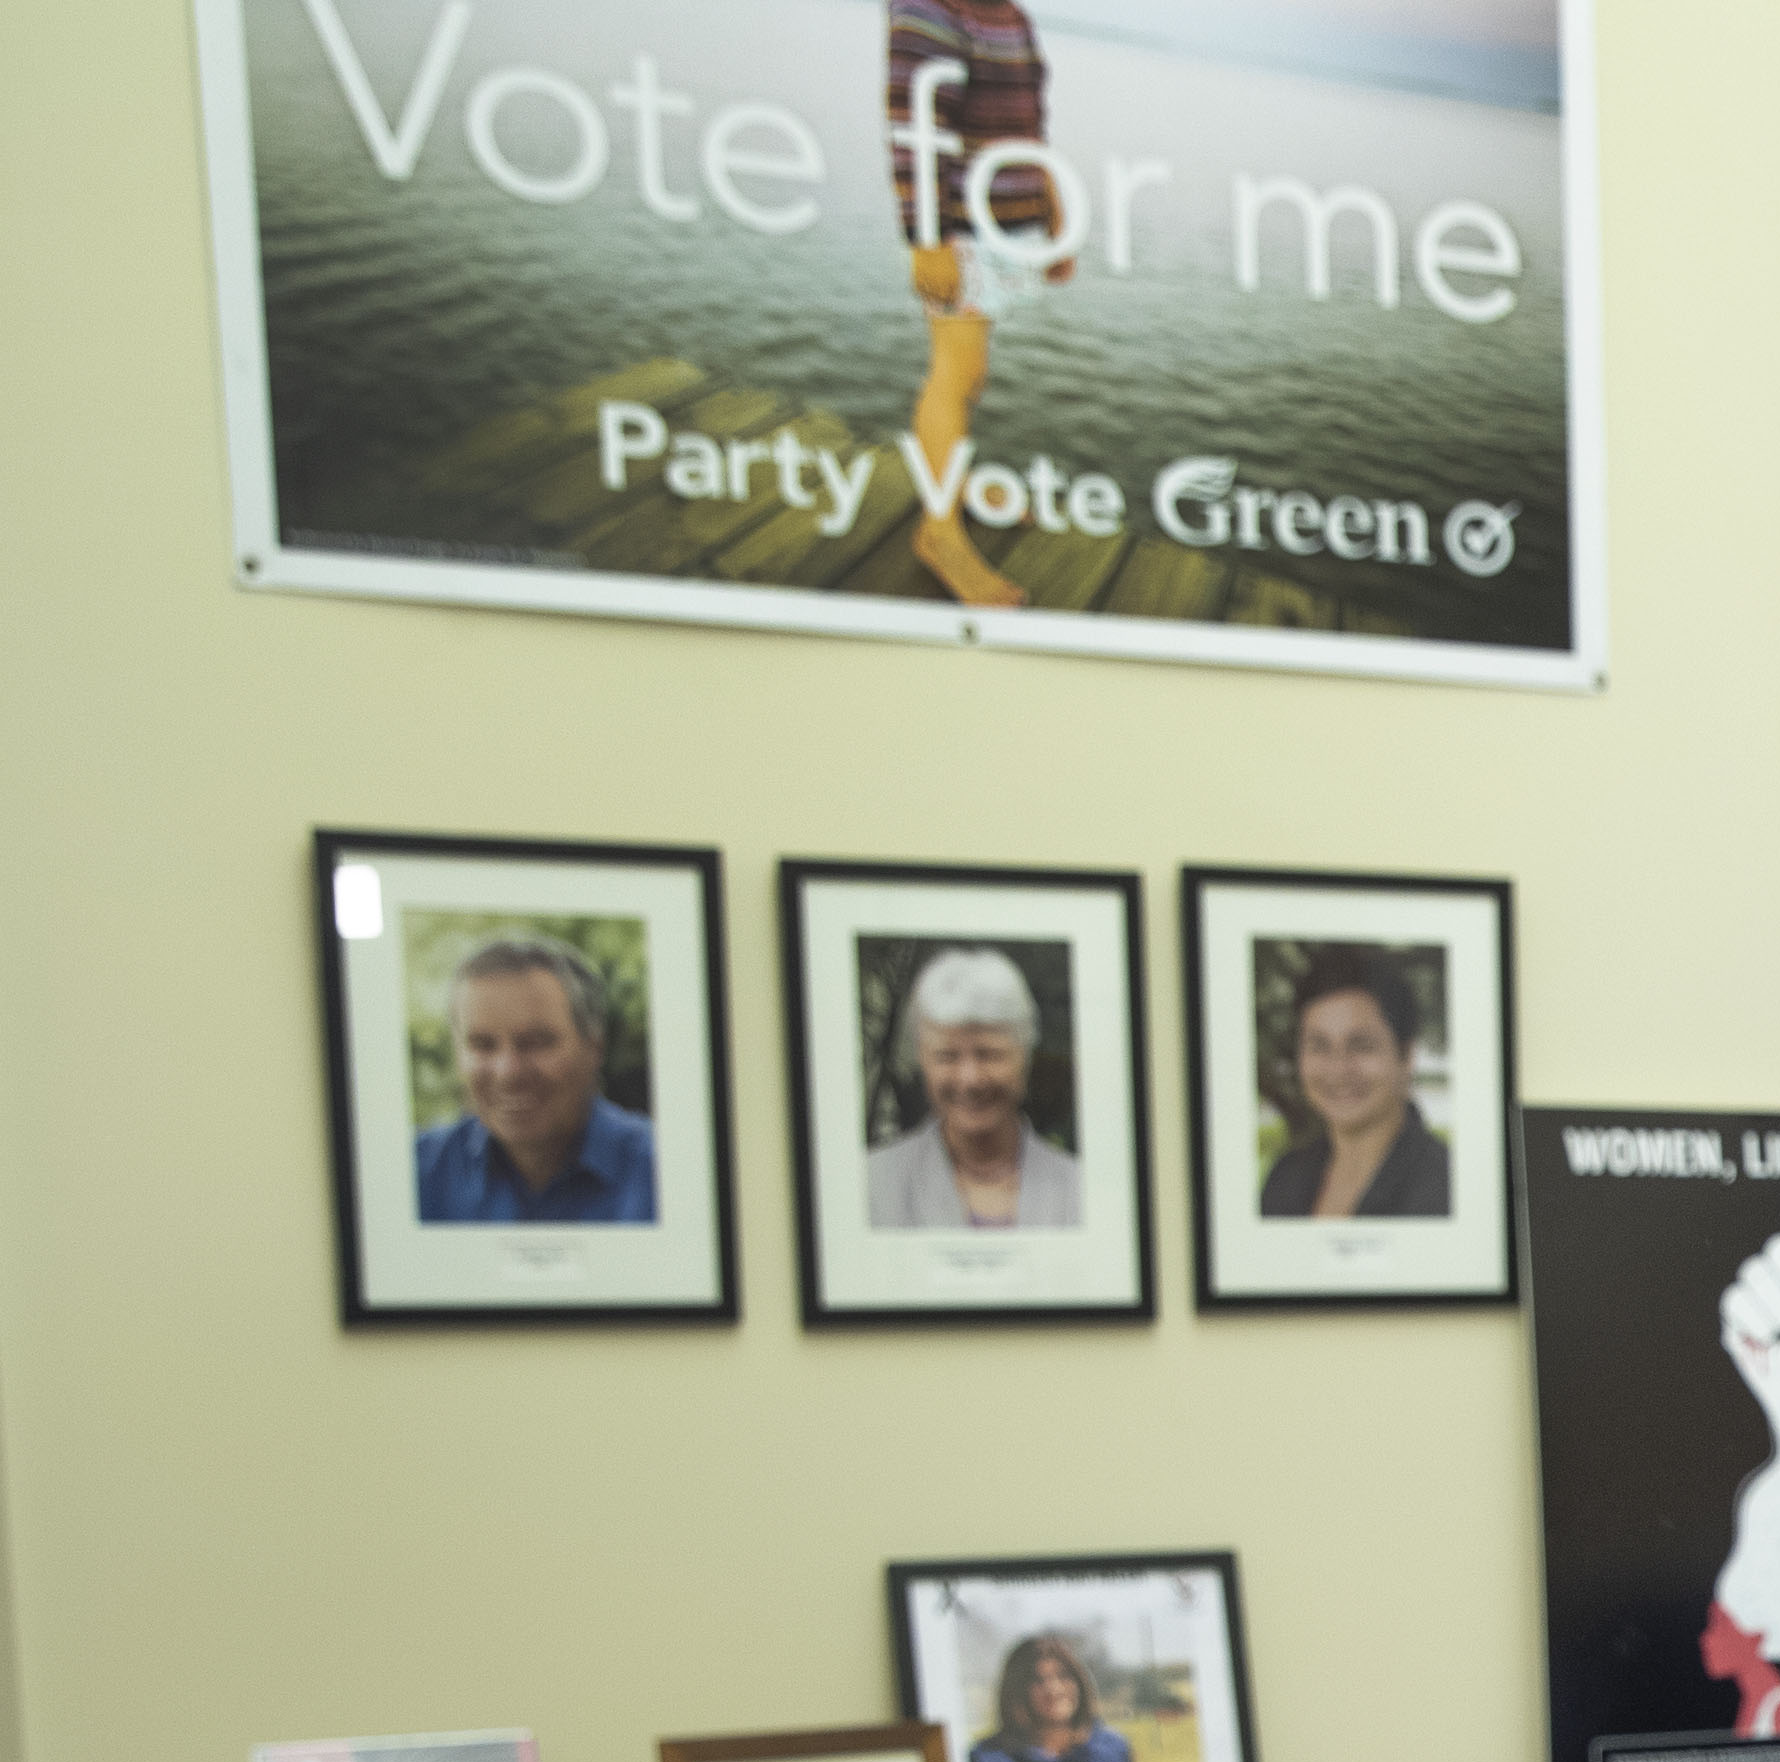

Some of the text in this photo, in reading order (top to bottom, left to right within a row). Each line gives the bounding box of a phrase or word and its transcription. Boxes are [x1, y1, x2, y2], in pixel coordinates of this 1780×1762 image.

[308, 0, 1521, 324] Vote for me
[599, 402, 1433, 567] Party Vote Green
[1563, 1127, 1737, 1184] WOMEN,
